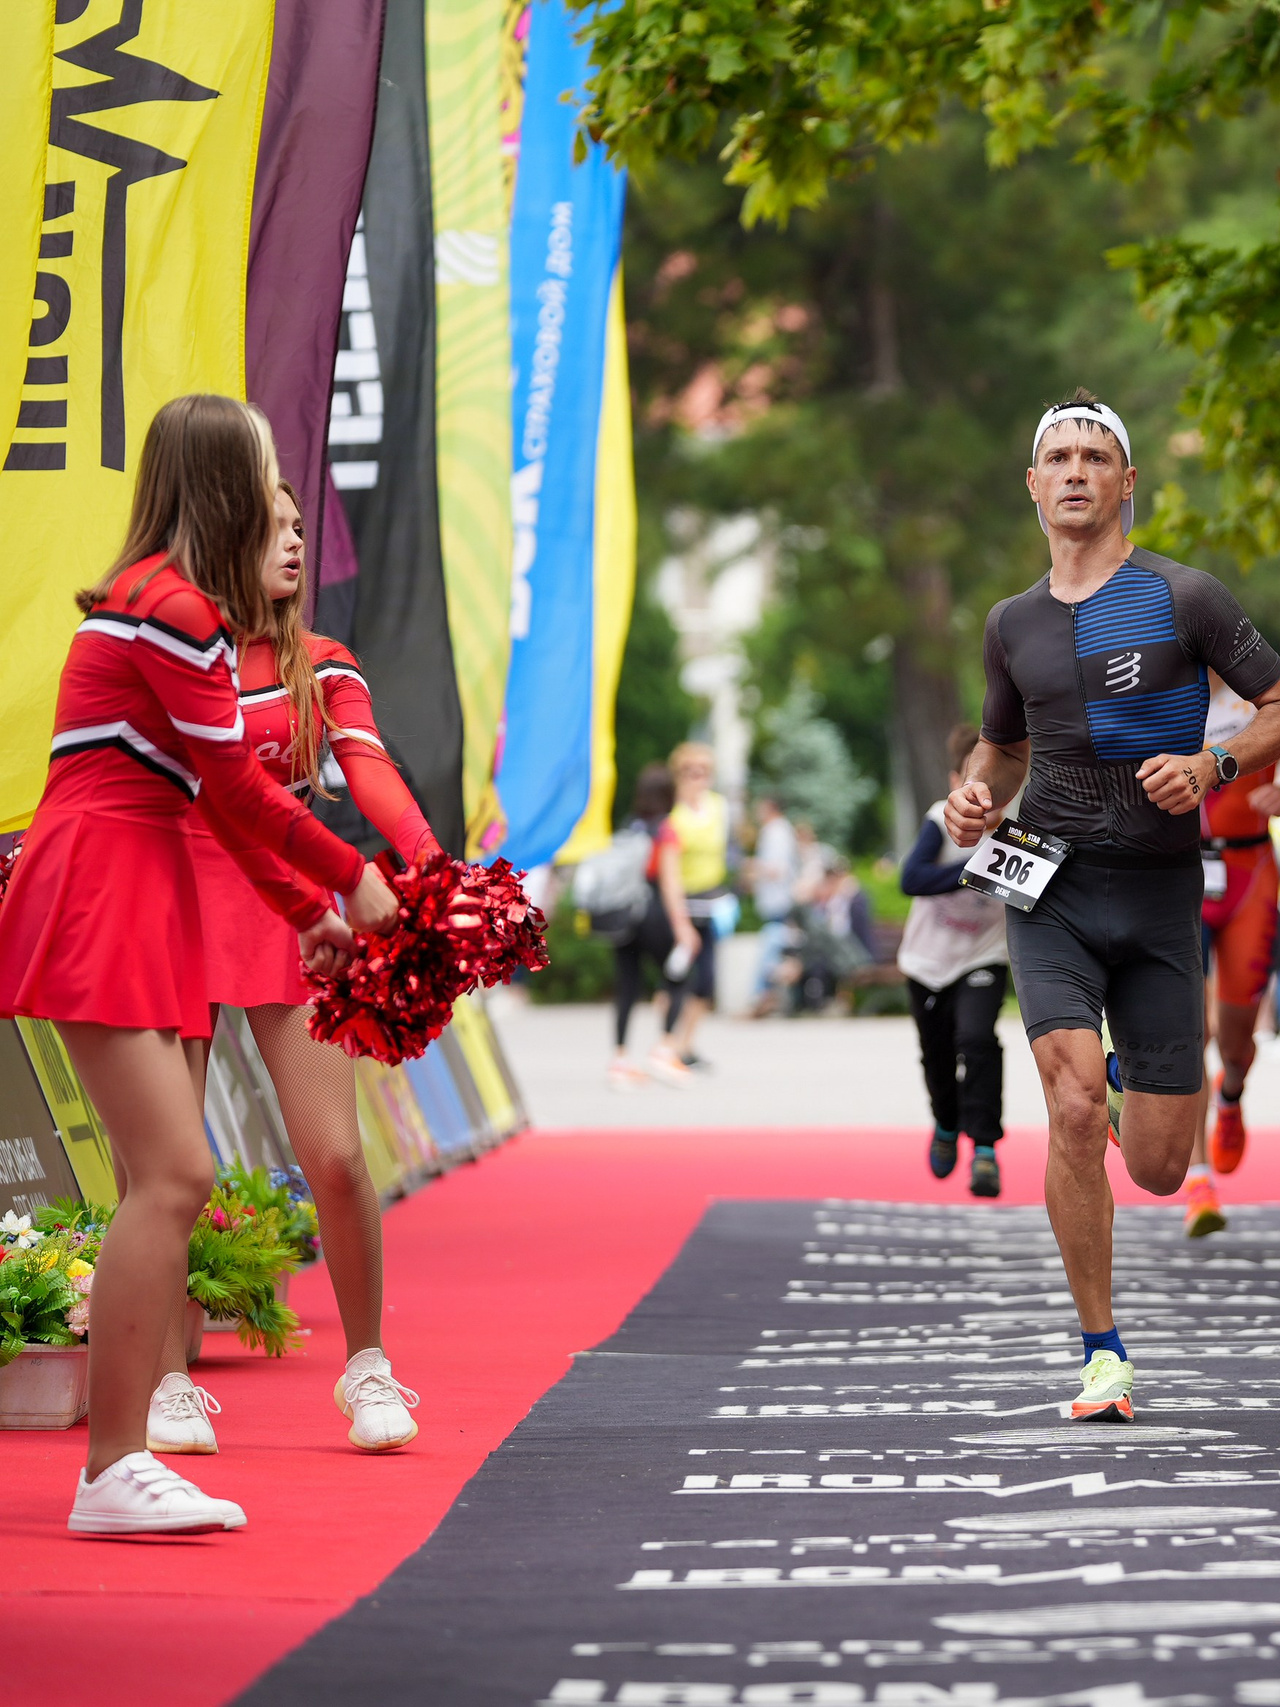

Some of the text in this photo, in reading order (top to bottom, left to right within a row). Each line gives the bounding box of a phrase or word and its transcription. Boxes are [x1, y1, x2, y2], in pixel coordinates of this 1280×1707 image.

[1183, 767, 1200, 794] 206
[1008, 827, 1023, 837] IRON
[1027, 833, 1041, 844] STAR
[987, 848, 1034, 885] 206
[995, 886, 1011, 898] DENIS
[718, 1400, 997, 1416] IRON
[683, 1473, 1001, 1488] IRON
[630, 1564, 1001, 1583] IRON
[549, 1677, 1000, 1702] IRON
